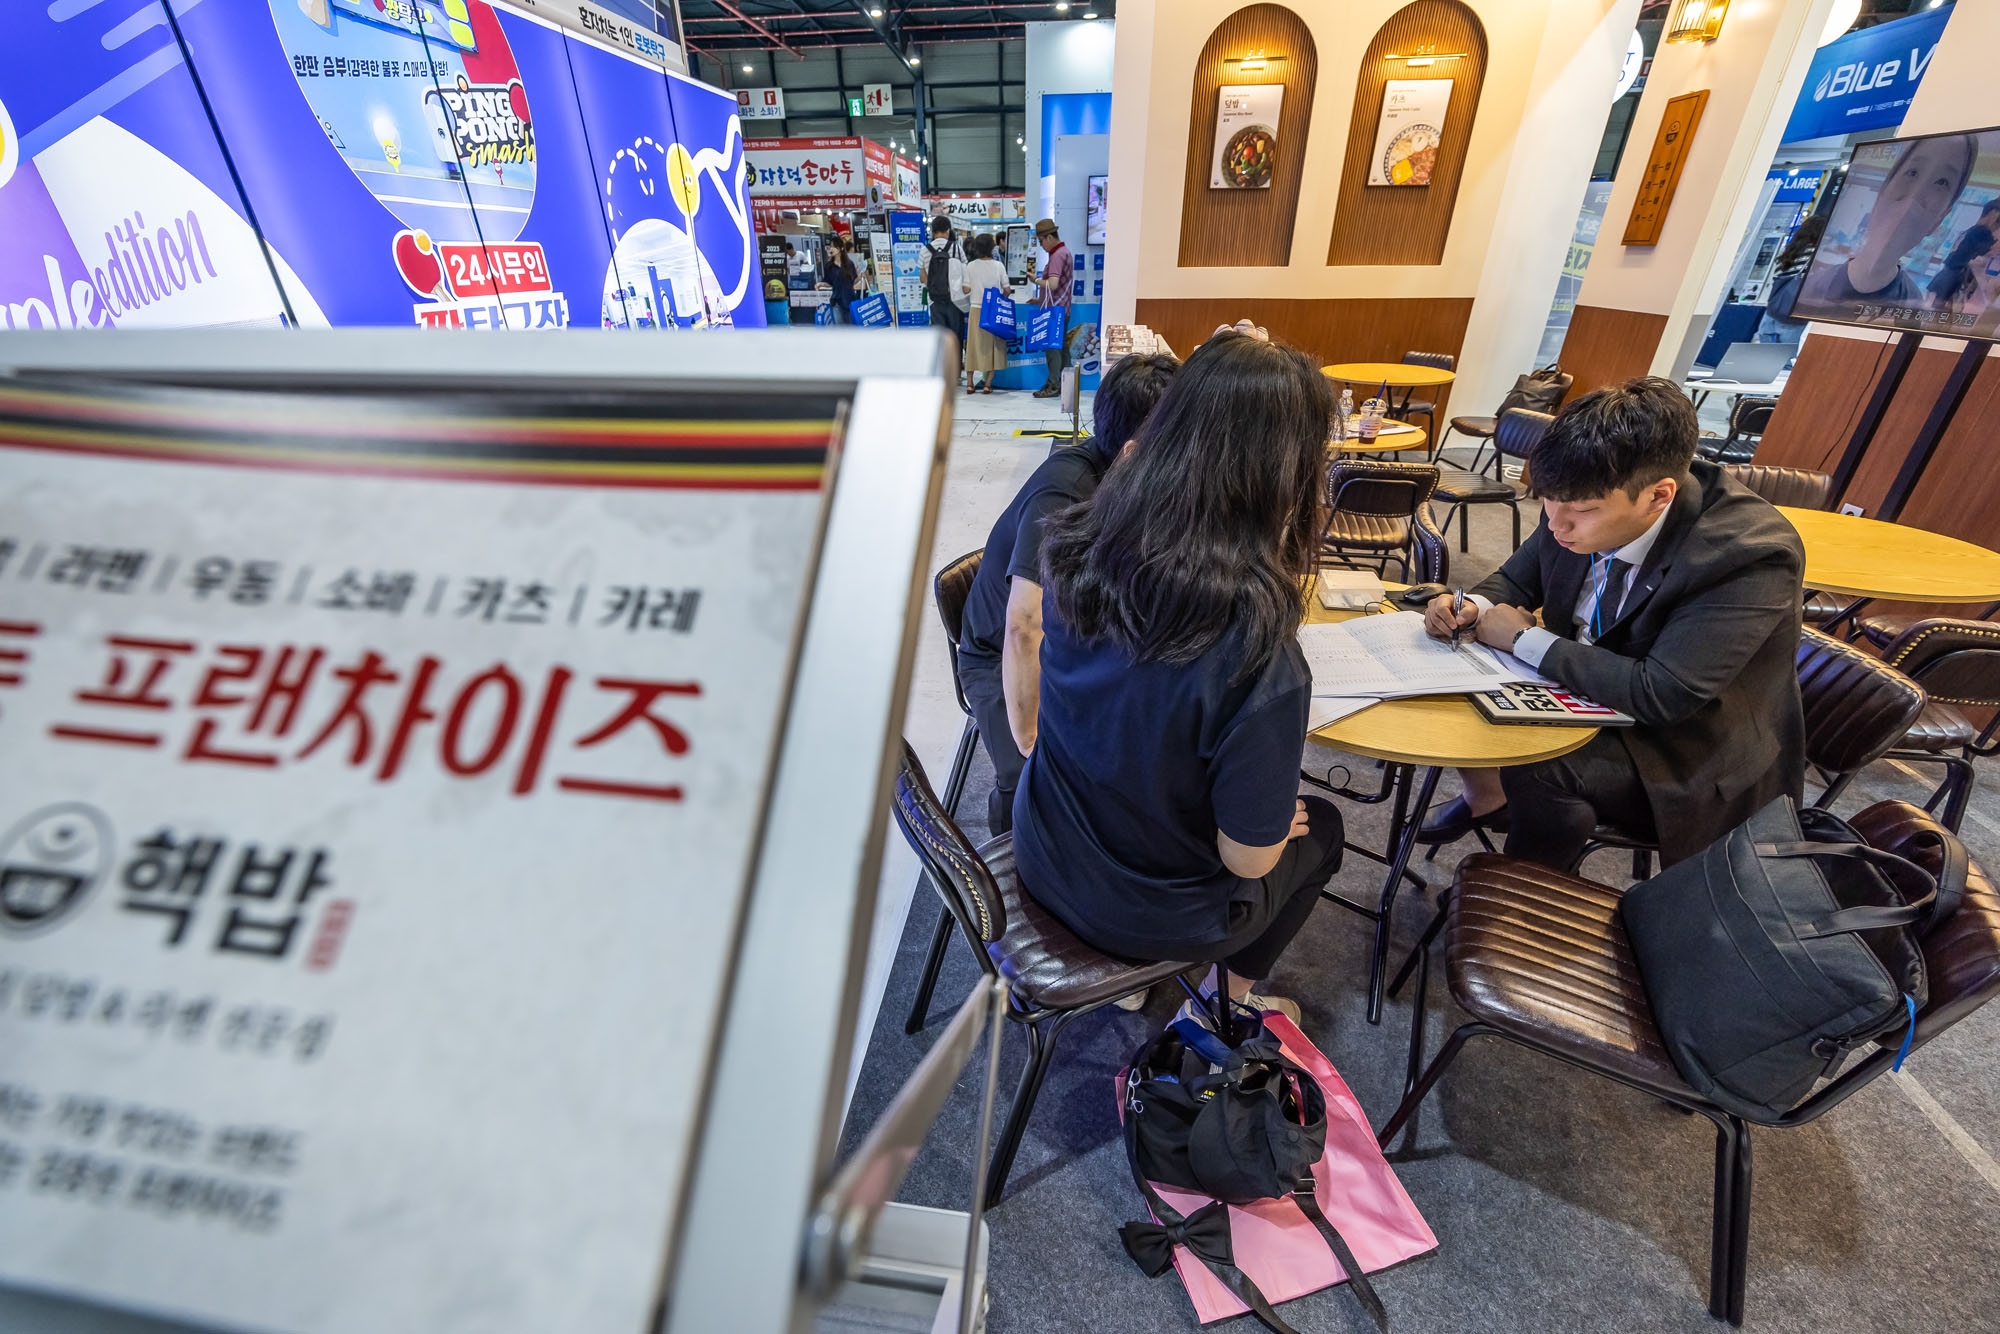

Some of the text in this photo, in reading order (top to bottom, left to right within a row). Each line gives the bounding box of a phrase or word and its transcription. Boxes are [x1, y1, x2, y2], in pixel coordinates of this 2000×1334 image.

[578, 6, 666, 62] 혼자치는 1인 로봇탁구
[293, 54, 319, 77] 한판
[381, 60, 400, 78] 불꽃
[402, 61, 428, 78] 스매싱
[1827, 60, 1901, 98] Blue
[448, 91, 512, 119] PING
[760, 106, 782, 117] 소화기
[866, 107, 880, 115] EXIT
[466, 131, 537, 168] smash
[1783, 177, 1820, 190] LARGE
[94, 209, 218, 318] edition
[449, 249, 547, 287] 24시무인
[1854, 304, 1881, 317] 그렇게
[1884, 307, 1913, 320] 생각을
[1914, 312, 1936, 322] 하게
[1938, 312, 1950, 324] 된
[48, 545, 147, 594] 라멘
[186, 556, 281, 606] 우동
[315, 569, 416, 617] 소바
[455, 575, 554, 624] 카츠
[597, 584, 703, 635] 카레
[47, 633, 703, 803] 프랜차이즈
[118, 825, 333, 960] 핵밥
